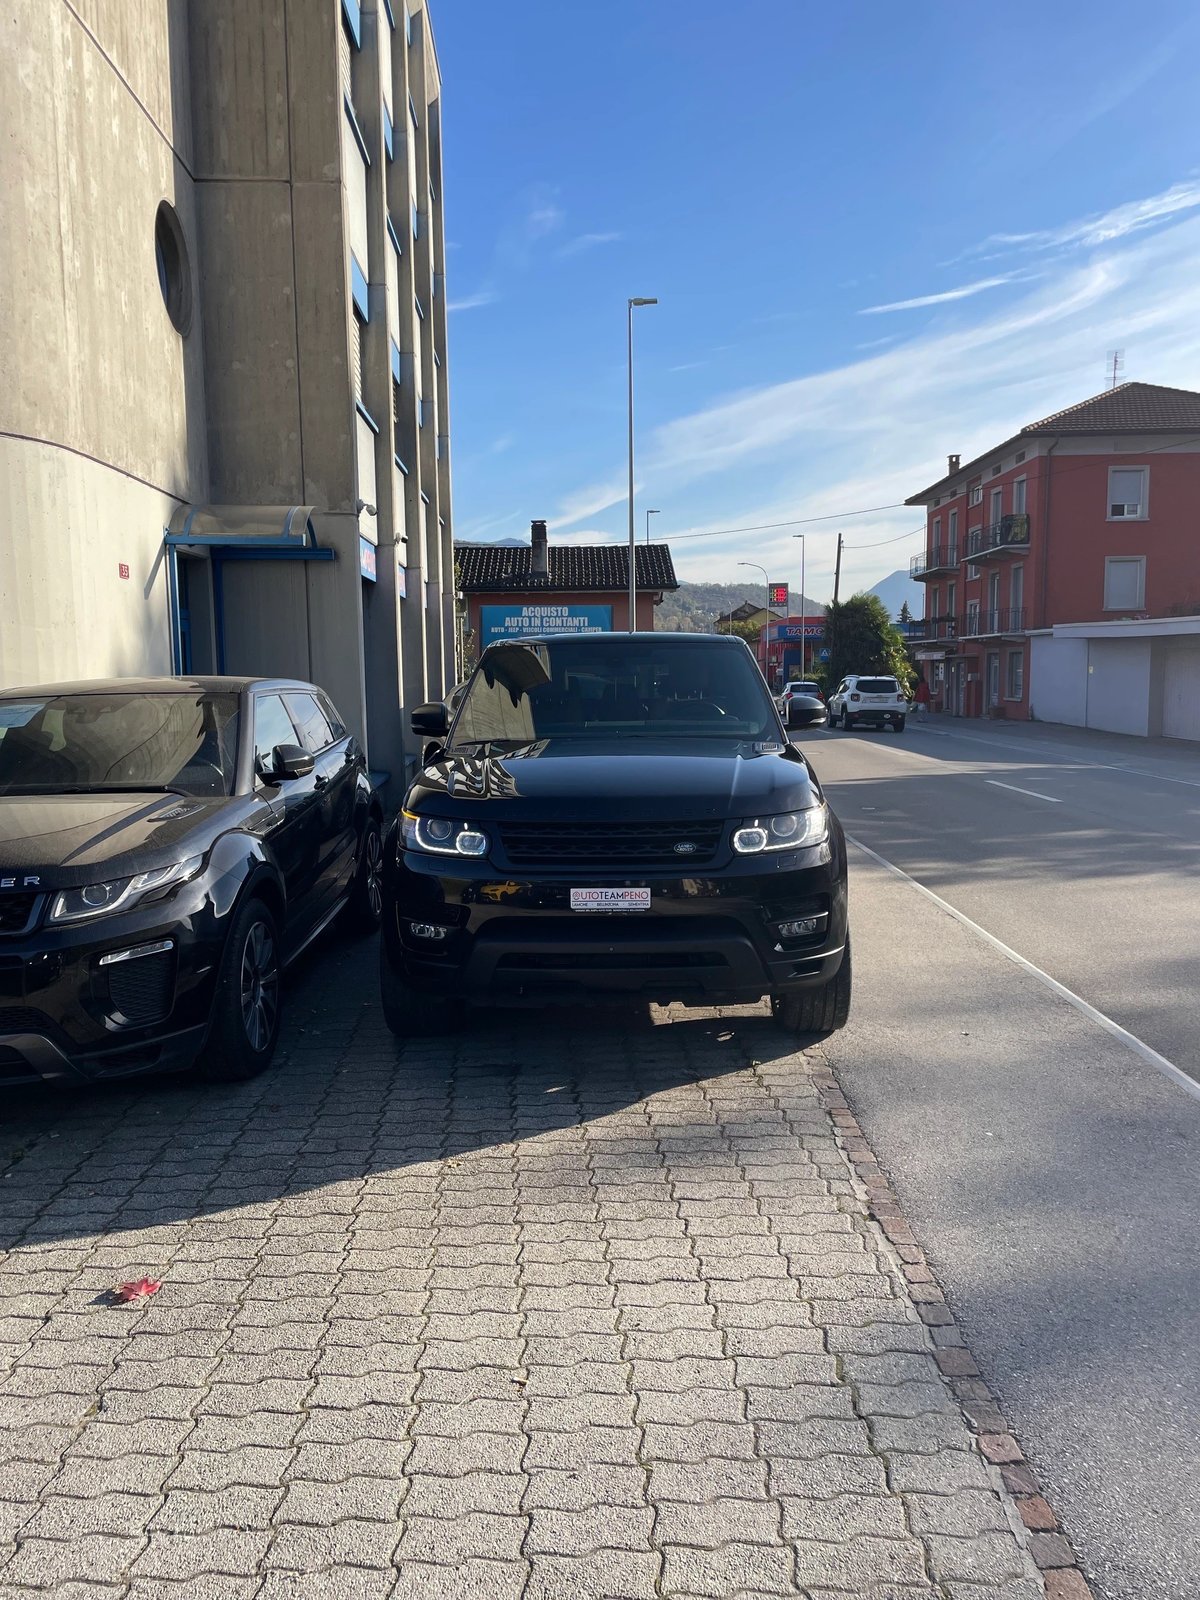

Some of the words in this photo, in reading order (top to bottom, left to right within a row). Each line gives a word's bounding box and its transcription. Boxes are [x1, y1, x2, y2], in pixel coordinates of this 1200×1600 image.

[522, 607, 569, 617] ACQUISTO
[505, 617, 530, 627] AUTO
[531, 617, 541, 627] IN
[541, 617, 588, 627] CONTANTI
